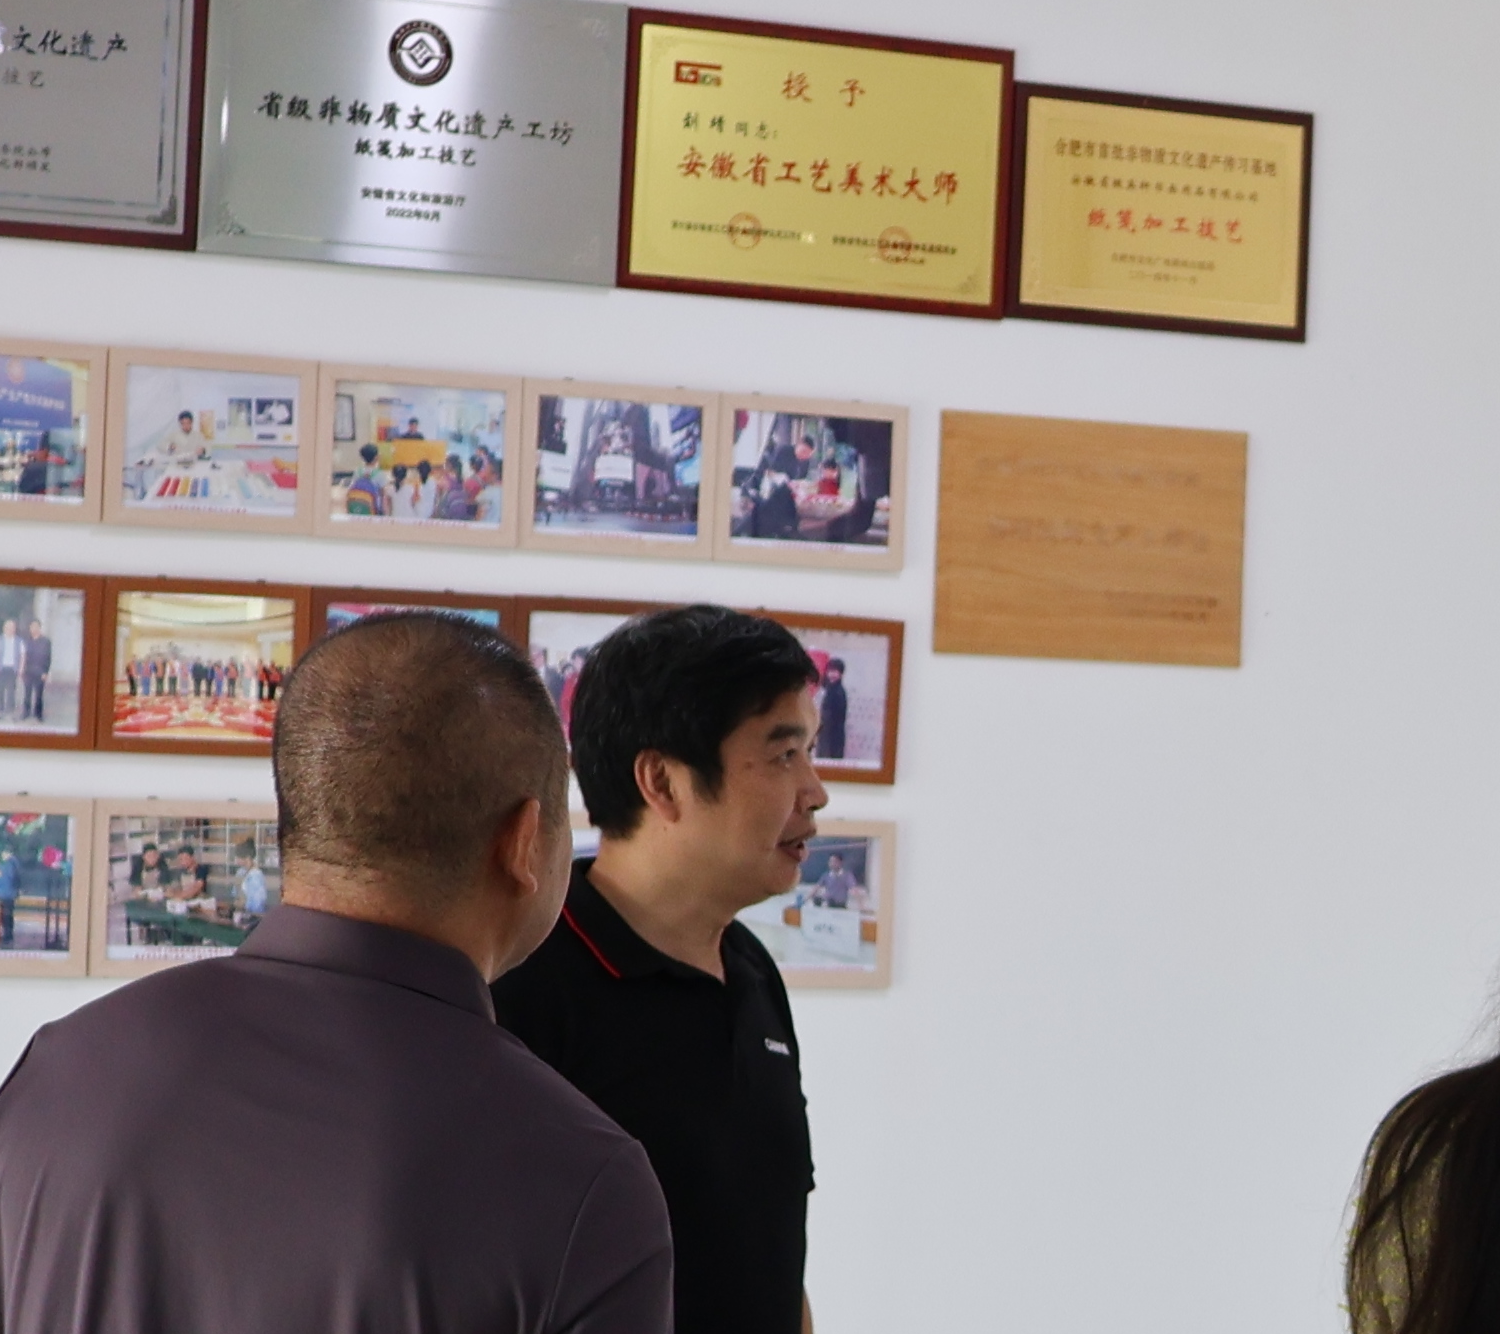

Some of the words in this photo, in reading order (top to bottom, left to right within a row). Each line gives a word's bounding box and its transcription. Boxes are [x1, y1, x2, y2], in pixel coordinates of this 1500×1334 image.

[257, 90, 575, 146] 省级非物质文化遗产工坊
[676, 146, 959, 205] 安徽省工艺美术大师
